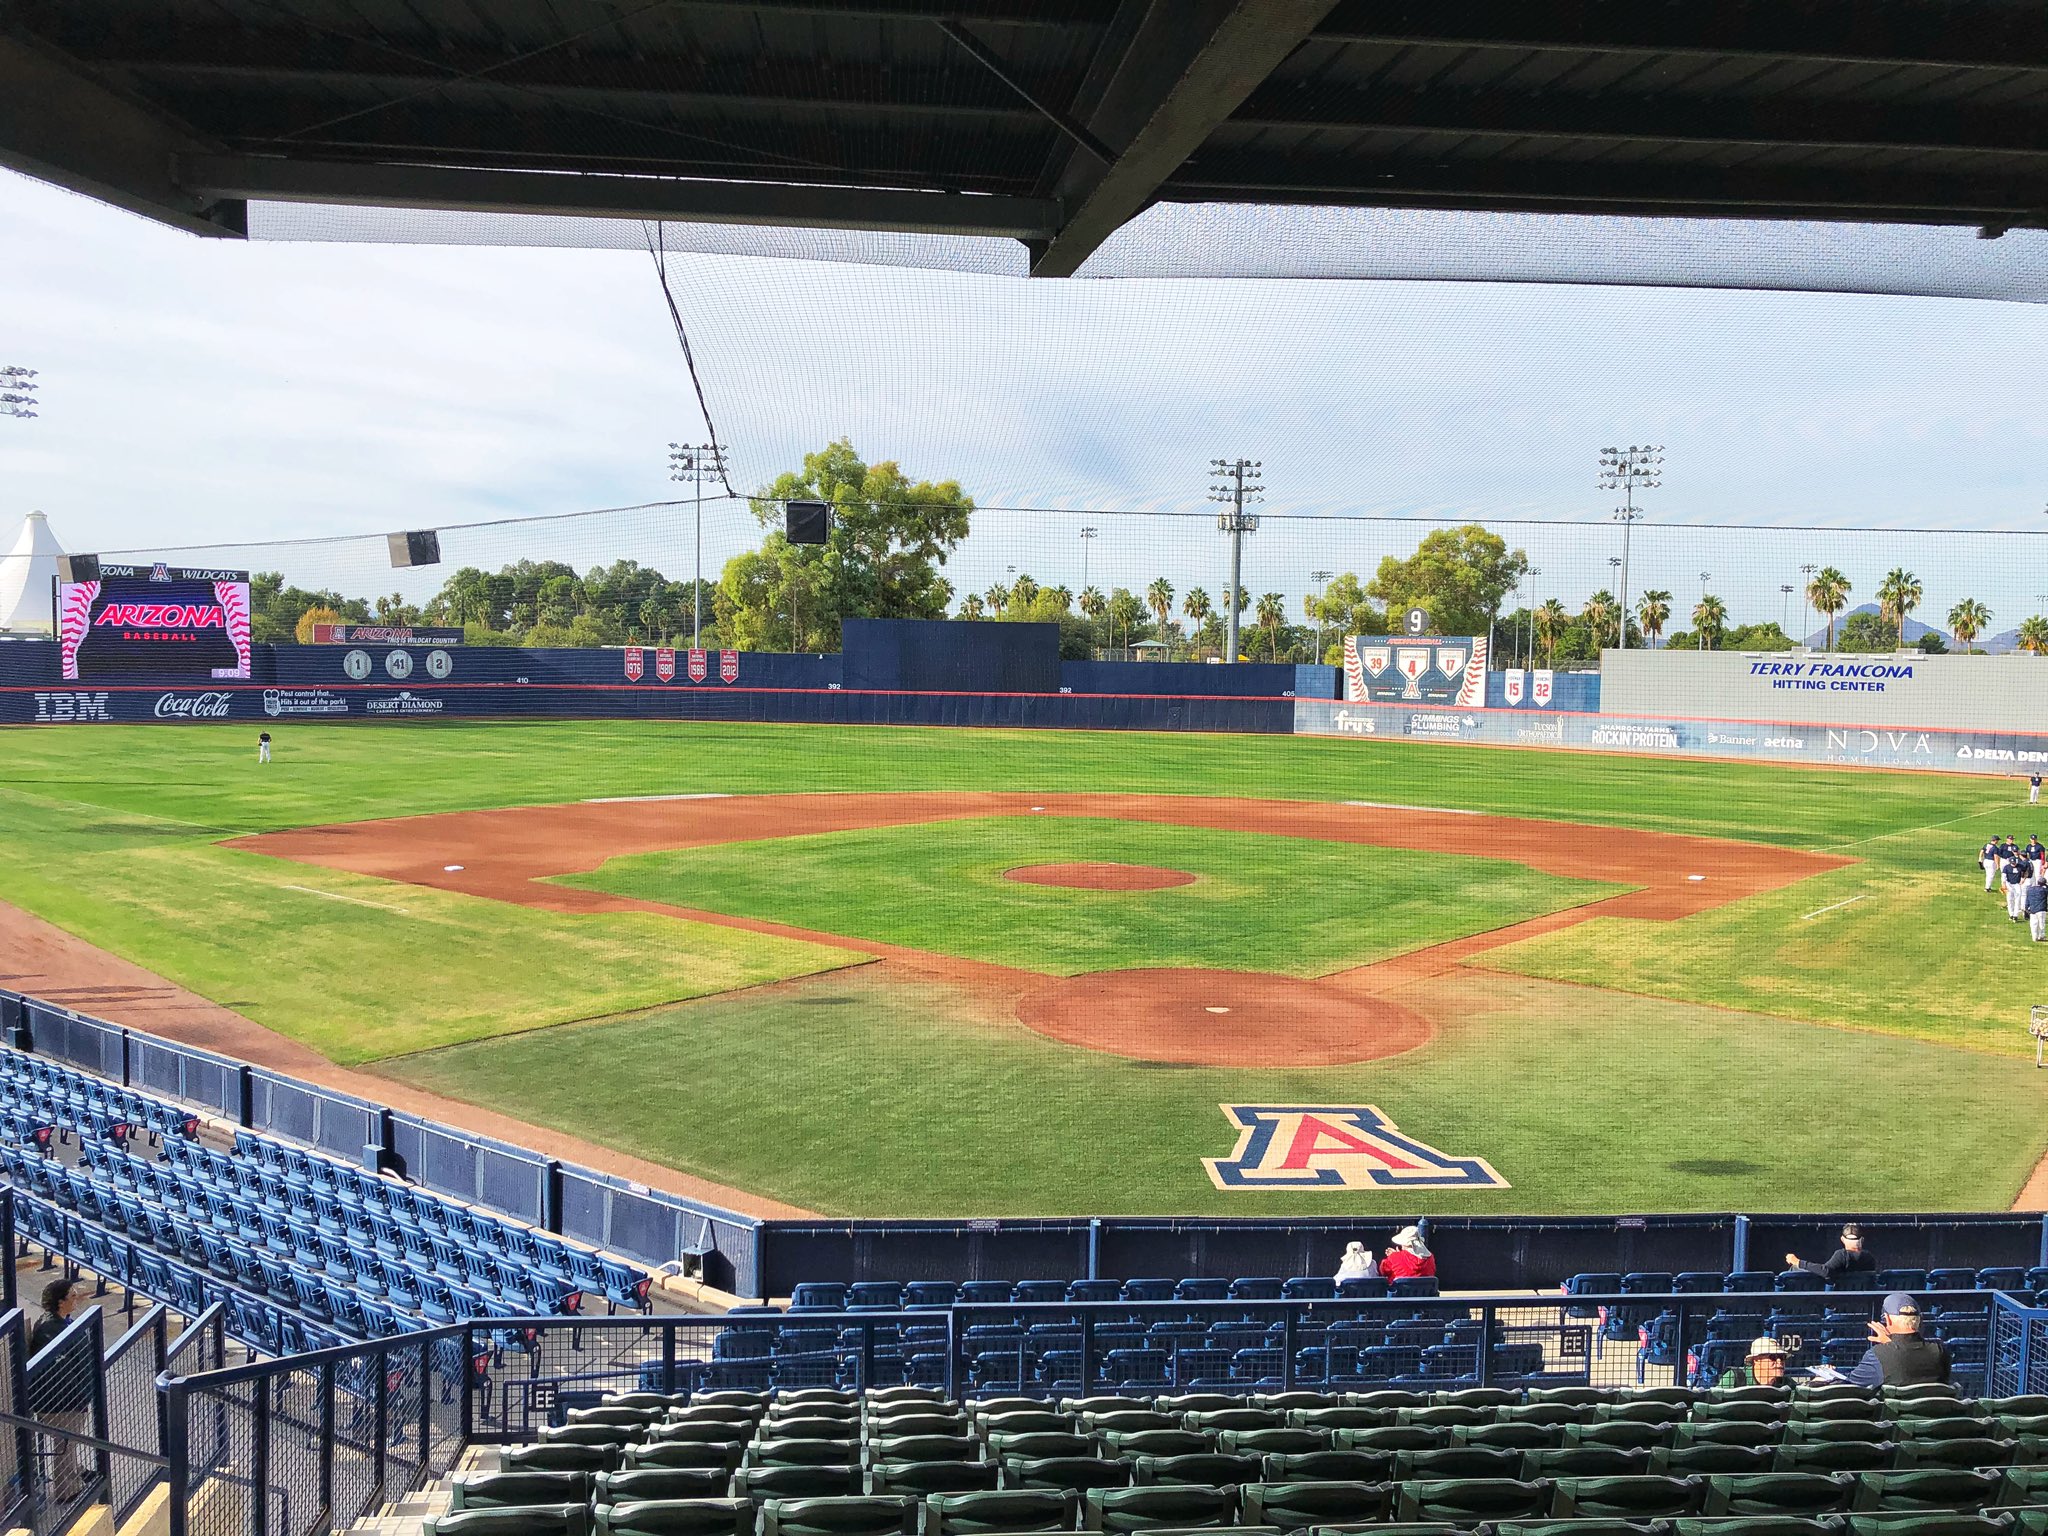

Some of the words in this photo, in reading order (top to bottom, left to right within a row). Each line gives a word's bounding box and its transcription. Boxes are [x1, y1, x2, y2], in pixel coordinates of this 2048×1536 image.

[101, 566, 134, 576] ZONA
[182, 569, 238, 581] WILDCATS
[95, 604, 225, 627] ARIZONA
[1410, 610, 1422, 632] 9
[123, 632, 197, 641] BASEBALL
[350, 627, 413, 640] ARIZONA
[355, 659, 361, 670] 1
[393, 658, 405, 669] 41
[436, 658, 443, 669] 2
[627, 663, 641, 673] 1976
[659, 664, 673, 674] 1980
[690, 664, 704, 675] 1986
[1370, 658, 1382, 669] 39
[1407, 660, 1416, 676] 4
[1446, 660, 1455, 671] 17
[218, 669, 240, 677] 9:09
[722, 665, 737, 676] 2012
[1750, 662, 1805, 676] TERRY
[1808, 664, 1913, 678] FRANCONA
[1509, 682, 1519, 696] 15
[1536, 683, 1549, 697] 32
[1773, 679, 1826, 691] HITTING
[1830, 681, 1885, 692] CENTER
[295, 689, 316, 697] control
[34, 692, 111, 721] IBM
[154, 692, 234, 718] Coca-Cola
[330, 698, 346, 706] park!
[367, 701, 399, 709] DESERT
[401, 701, 443, 709] DIAMOND
[1334, 709, 1375, 734] fry's
[1411, 714, 1460, 723] CUMMINGS
[1411, 722, 1460, 732] PLUMBING
[1600, 724, 1643, 732] SHAMROCK
[1719, 733, 1758, 746] Banner
[1764, 736, 1804, 749] aetna
[1827, 730, 1933, 754] NOVA
[1827, 754, 1869, 764] HOME
[1883, 756, 1932, 766] LOANS
[1973, 748, 2016, 760] DELTA
[2017, 750, 2048, 762] DEN
[1563, 1336, 1582, 1353] EE
[535, 1390, 555, 1408] EE
